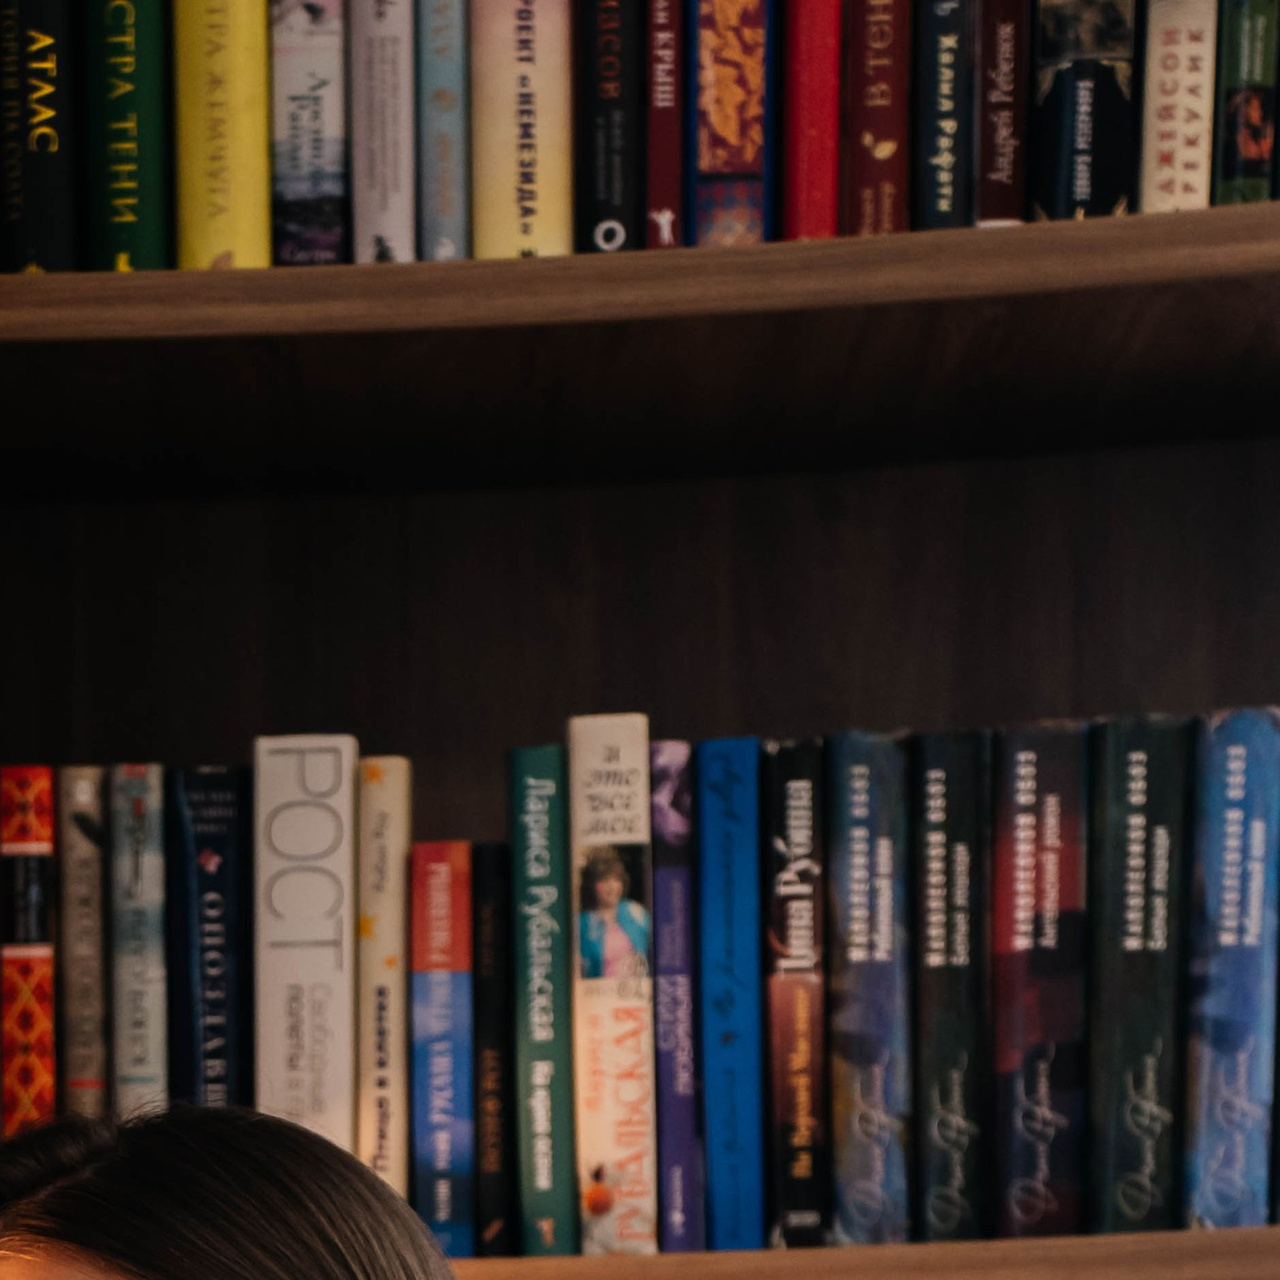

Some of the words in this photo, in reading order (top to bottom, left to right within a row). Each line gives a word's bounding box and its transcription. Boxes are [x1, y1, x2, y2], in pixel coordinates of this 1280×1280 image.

[26, 28, 61, 154] АТЛАС
[204, 71, 231, 218] ЖЕМЧУГА
[863, 81, 893, 107] В
[985, 109, 1020, 185] Андрей
[1156, 26, 1181, 196] ДЖЕЙСОН
[107, 112, 140, 224] ТЕНИ
[514, 73, 539, 238] «НЕМЕЗИДА»
[927, 118, 959, 213] Рафати
[263, 746, 346, 973] РОСТ
[520, 777, 558, 878] Лариса
[773, 778, 822, 897] Рубина
[519, 884, 560, 1043] Рубальская
[776, 901, 820, 984] Дина
